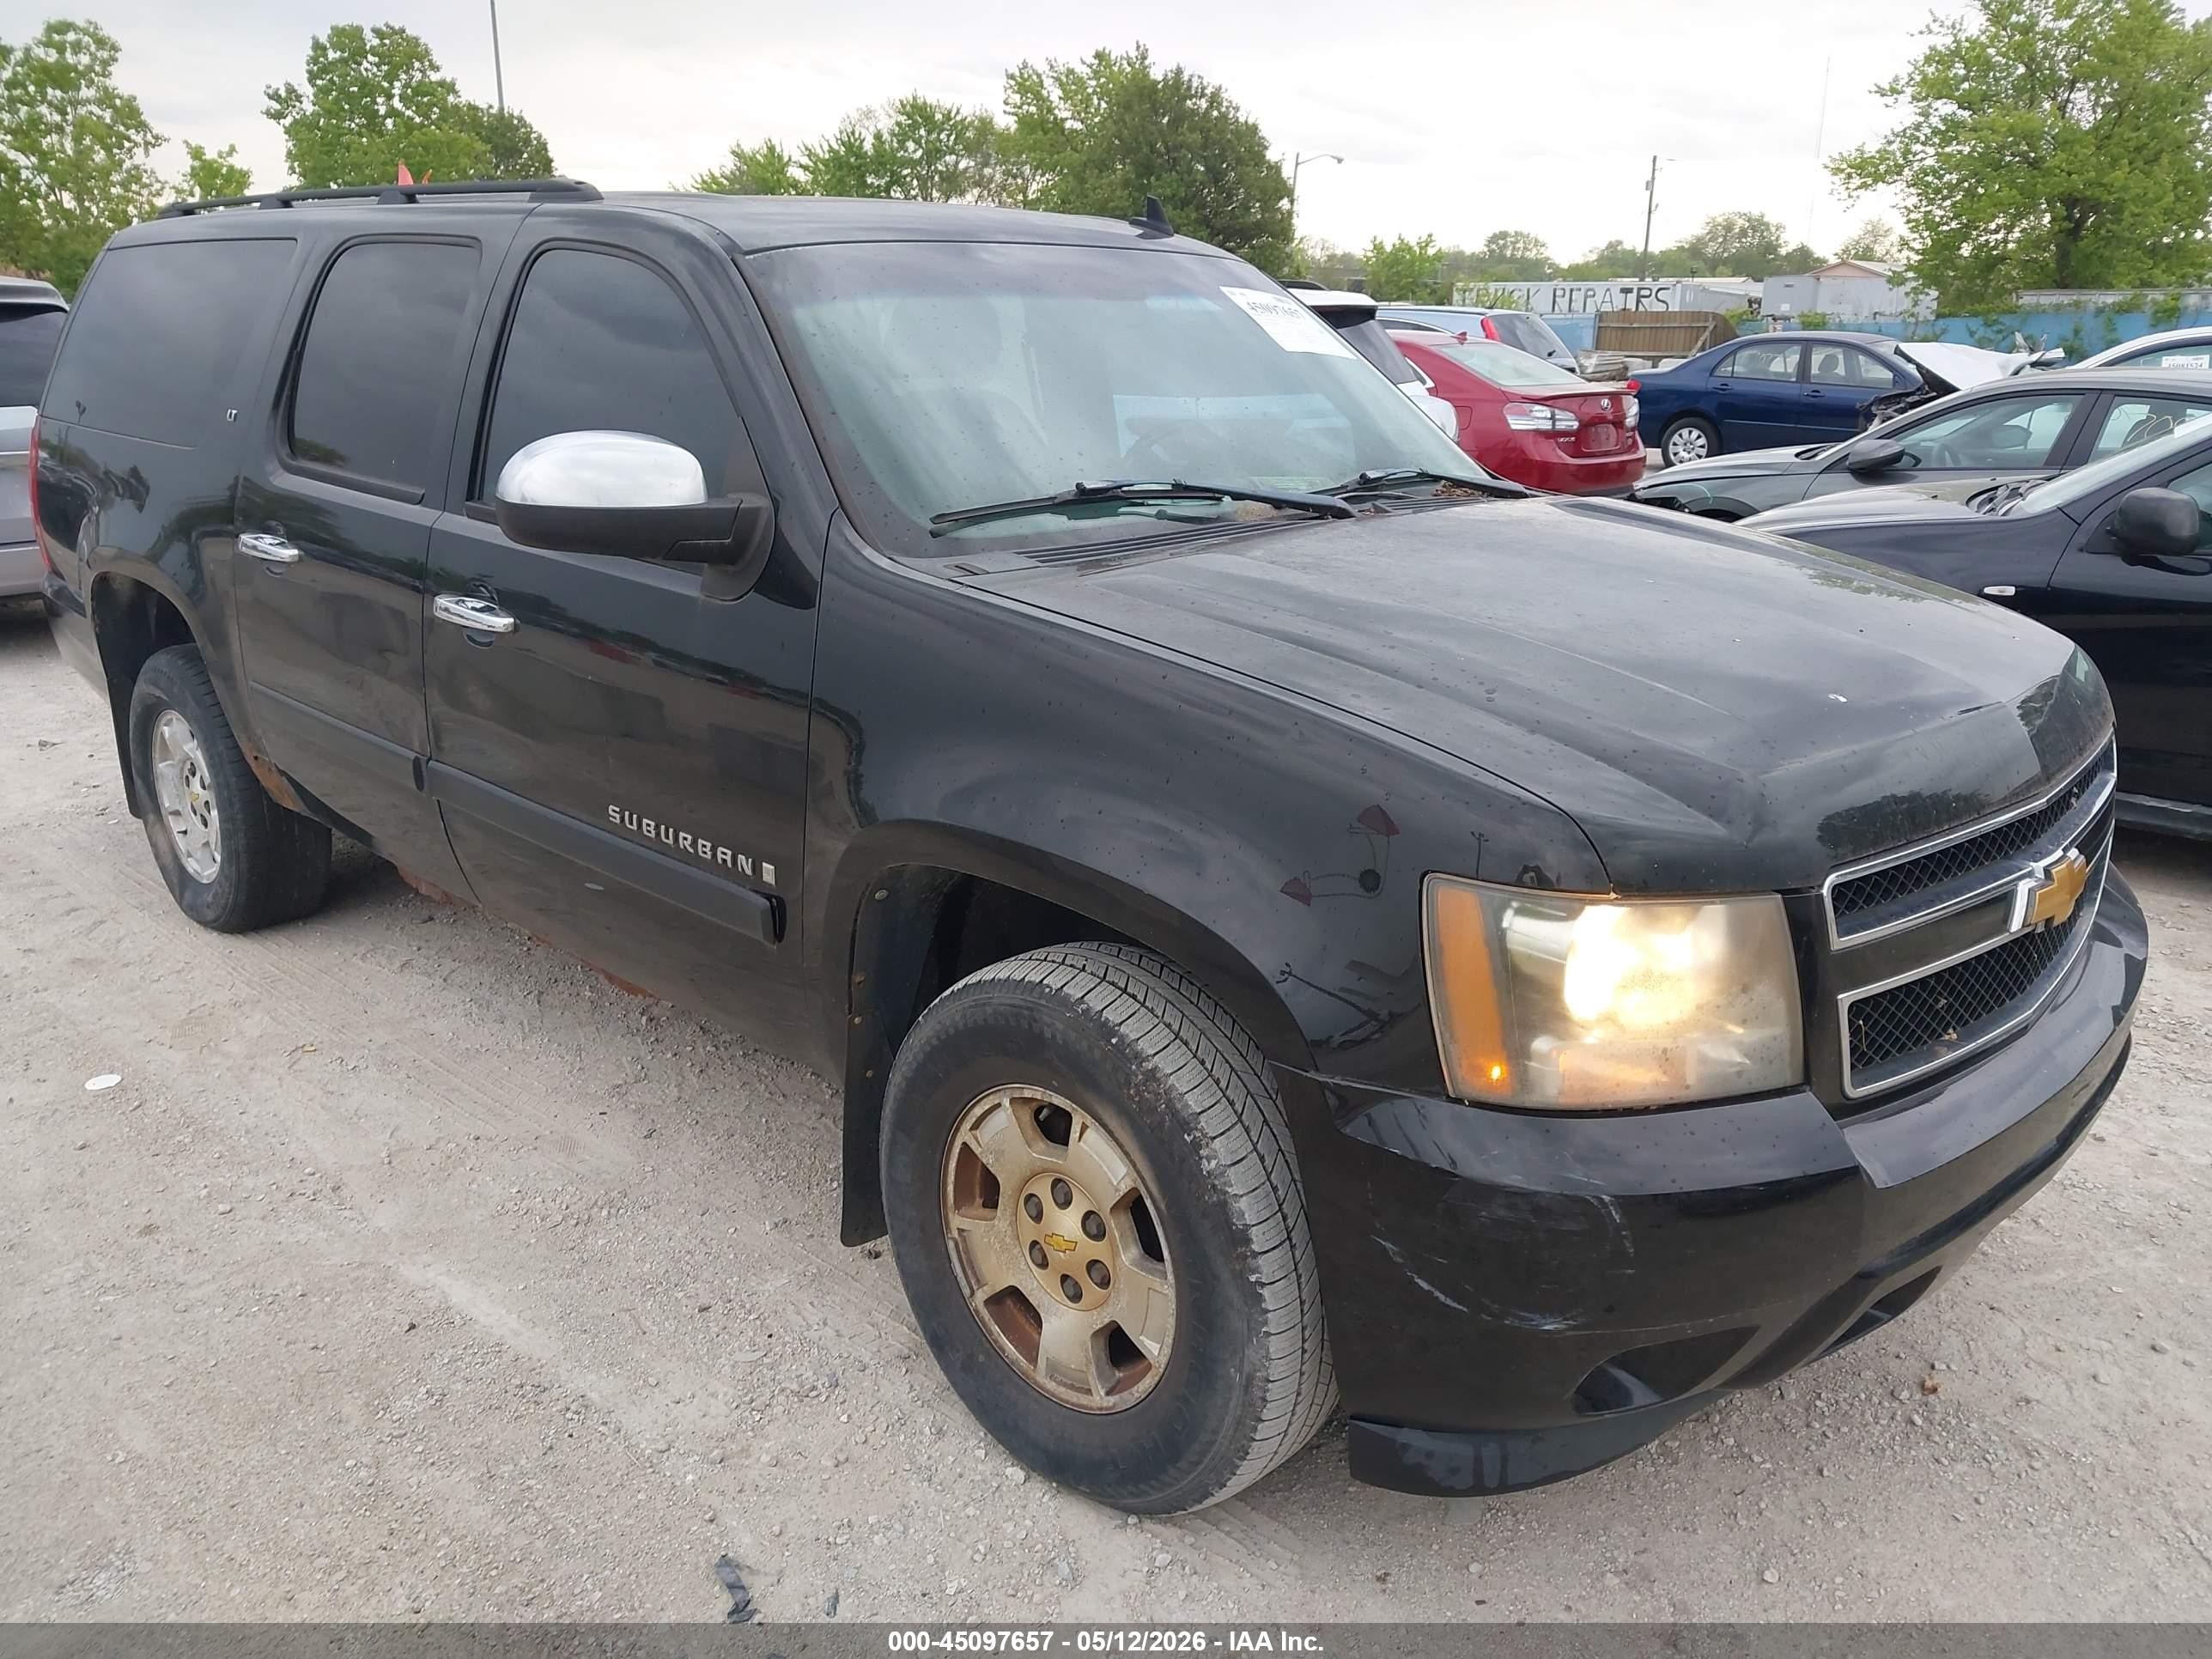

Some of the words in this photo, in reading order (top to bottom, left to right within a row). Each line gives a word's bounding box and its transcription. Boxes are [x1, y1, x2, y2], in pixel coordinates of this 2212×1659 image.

[1552, 287, 1670, 313] REPAIRS
[226, 408, 238, 422] LT
[608, 804, 753, 877] SUBURBAN
